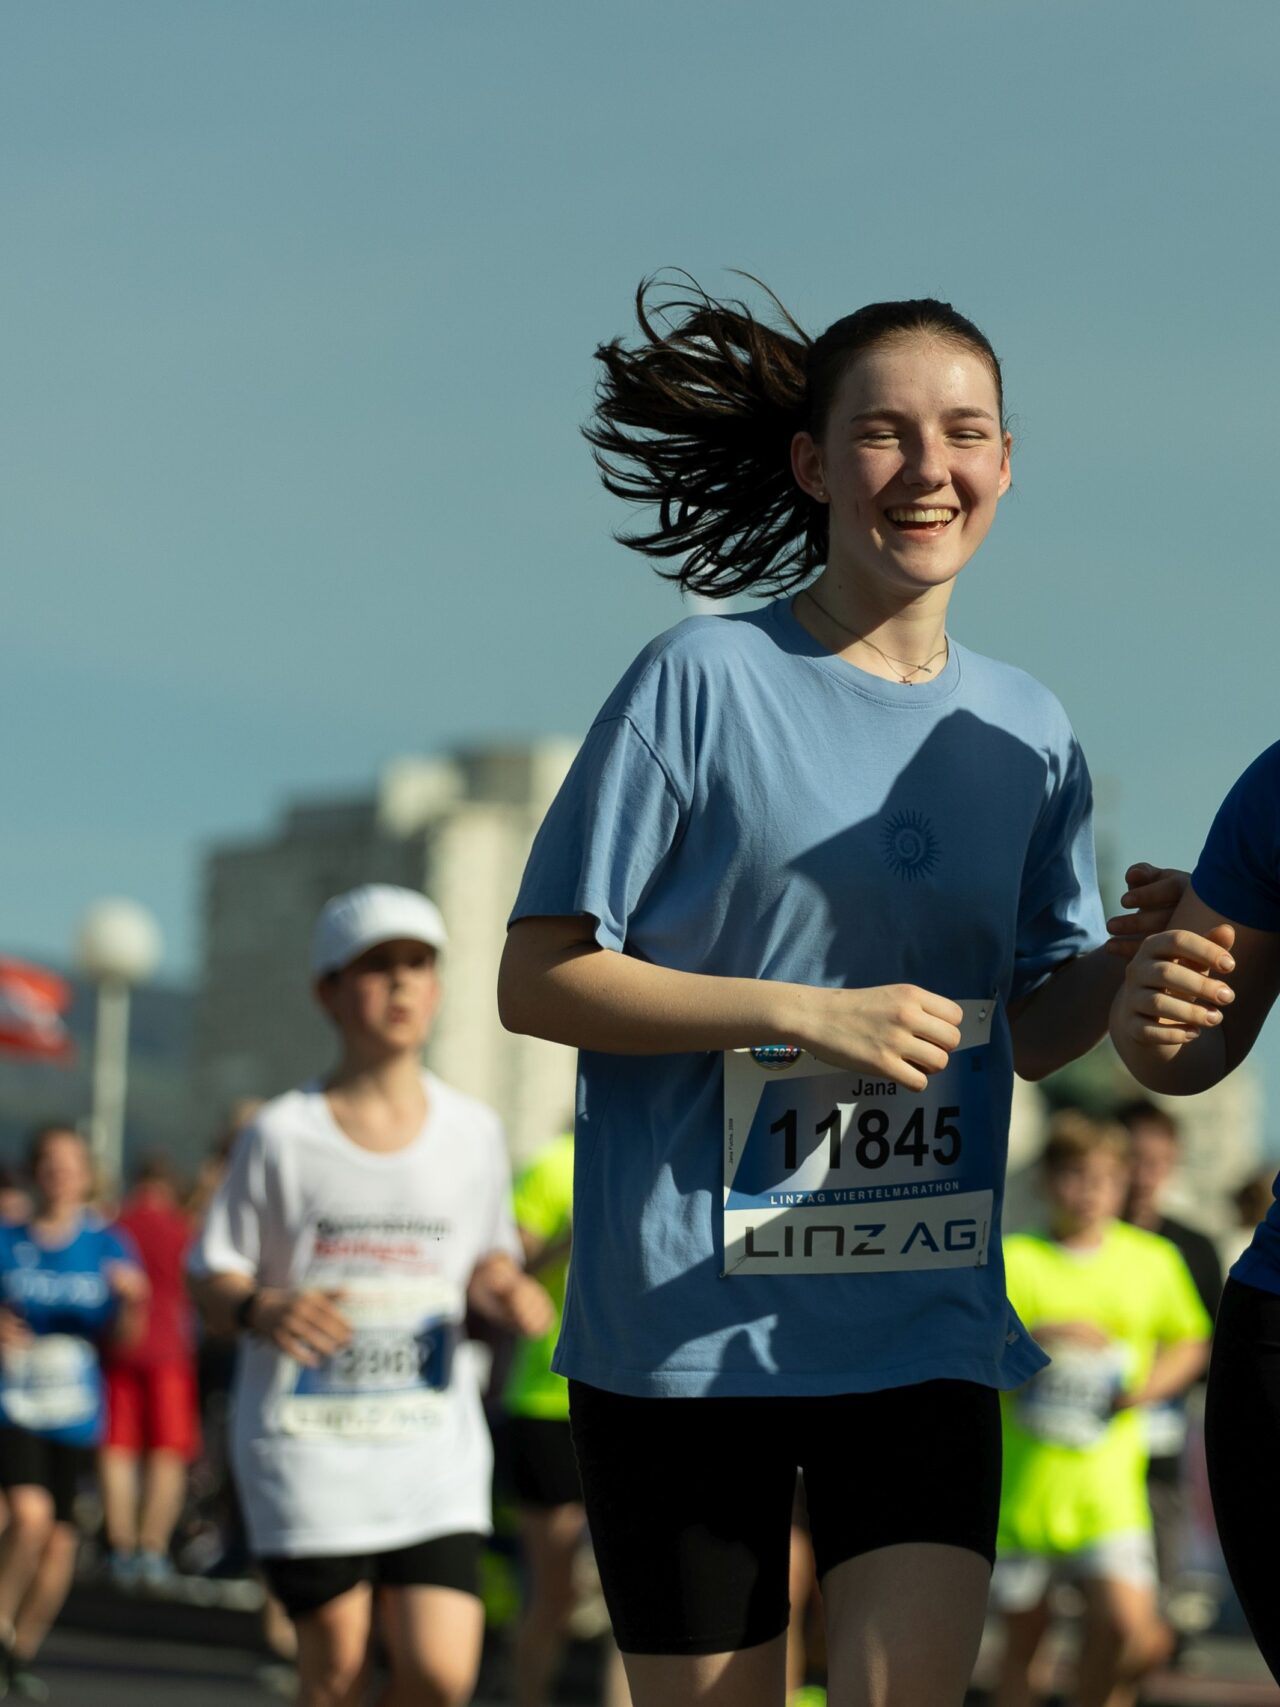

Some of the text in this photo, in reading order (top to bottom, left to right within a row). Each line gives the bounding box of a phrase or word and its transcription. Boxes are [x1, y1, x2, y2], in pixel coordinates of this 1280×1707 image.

[852, 1079, 897, 1097] Jana
[770, 1105, 963, 1170] 11845
[834, 1181, 960, 1202] VIERTELMARATHON
[745, 1219, 977, 1258] LINZ AG
